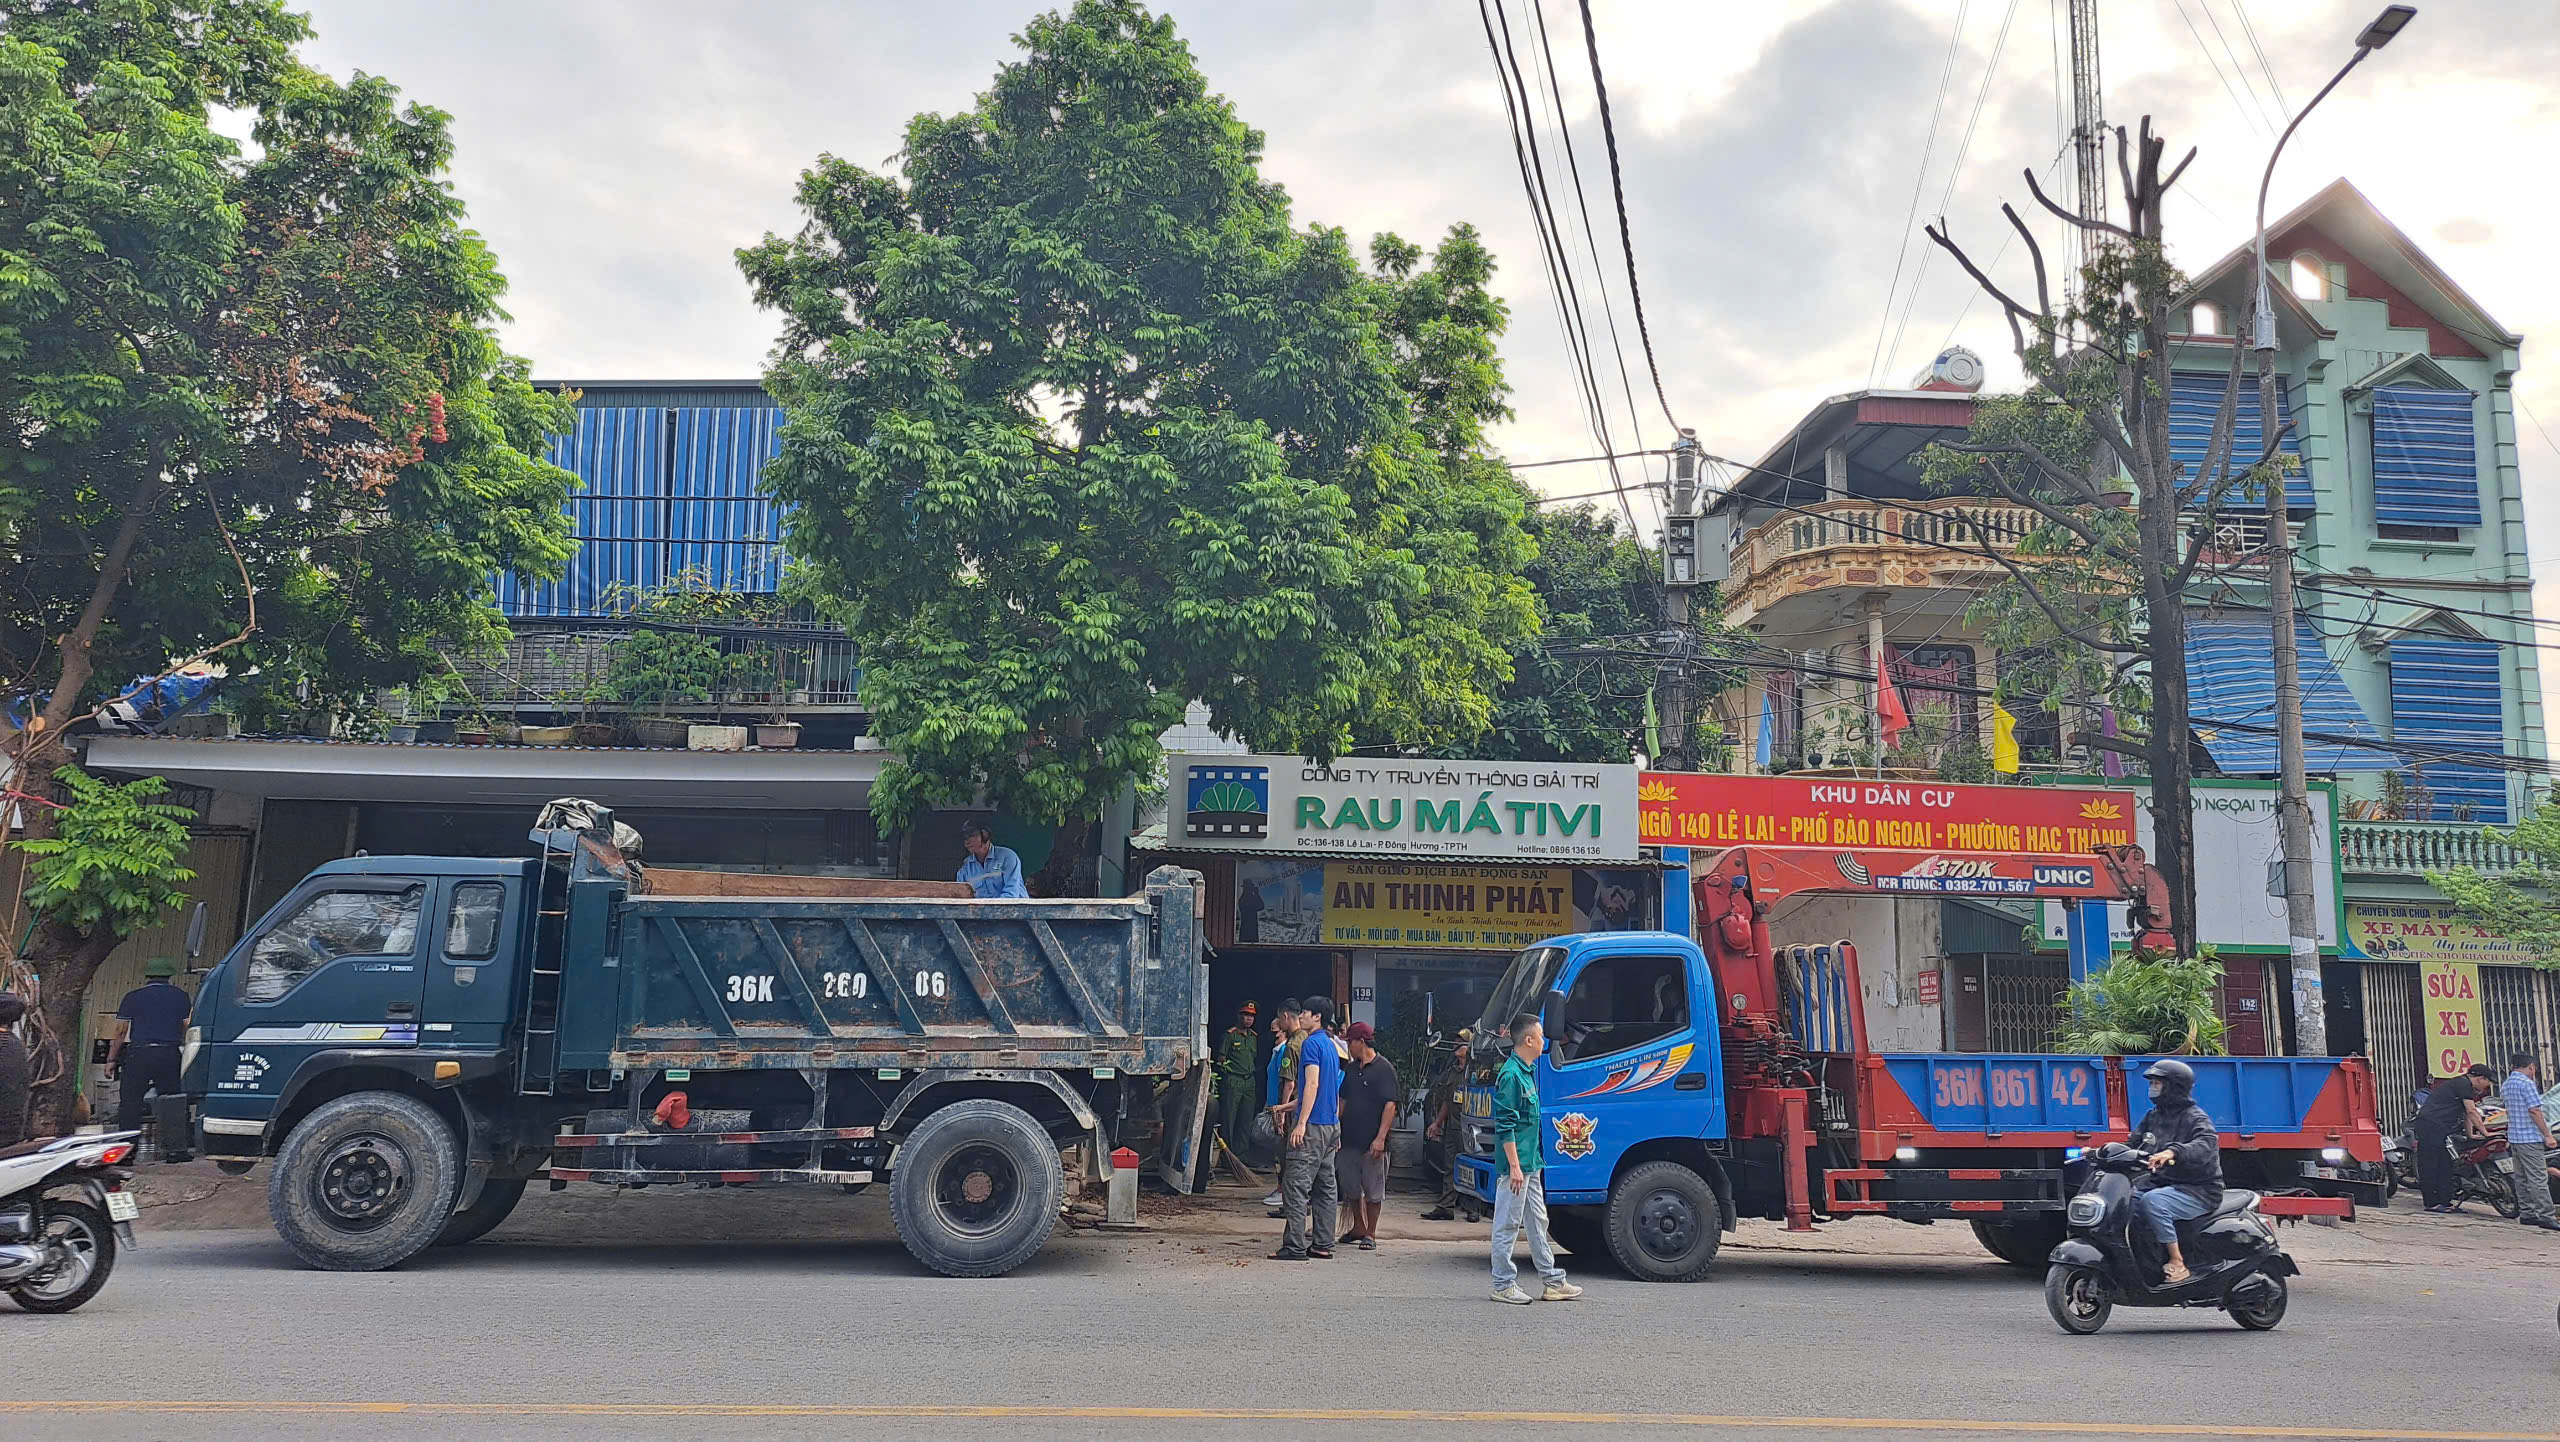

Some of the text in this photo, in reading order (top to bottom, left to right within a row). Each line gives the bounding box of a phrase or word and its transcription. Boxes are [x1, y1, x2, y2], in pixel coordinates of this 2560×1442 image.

[1302, 765, 1600, 789] CÔNG TY TRUYỀN THÔNG GIẢI TRÍ
[1811, 784, 1955, 808] KHU DÂN CƯ
[1296, 796, 1402, 831] RAU
[1639, 806, 1672, 838] NGÕ
[1678, 811, 1710, 839] 140
[1717, 808, 1739, 841] LÊ
[1744, 814, 1776, 842] LAI
[1791, 809, 1829, 844] PHỐ
[1833, 812, 1870, 846] BÀO
[1947, 818, 2021, 851] PHƯỜNG
[1347, 839, 1358, 849] Lê
[1410, 841, 1439, 852] Hương
[1517, 844, 1548, 854] Hotline:
[1550, 845, 1570, 854] 0896
[1415, 866, 1446, 879] DỊCH
[2034, 869, 2091, 885] UNIC
[1902, 877, 1942, 891] HÙNG:
[1945, 879, 2031, 893] 0382.701.567
[1333, 881, 1564, 917] AN THỊNH PHÁT
[2356, 905, 2389, 917] CHUYÊN
[1406, 929, 1423, 942] MUA
[2363, 921, 2395, 935] XE
[2402, 920, 2453, 936] MÁY
[2437, 951, 2460, 960] CHO
[726, 975, 775, 1002] 36K
[2427, 963, 2474, 999] SỬA
[1355, 988, 1371, 997] 138
[2438, 1011, 2470, 1036] XE
[1604, 1059, 1629, 1072] THACO
[2441, 1048, 2473, 1074] GA
[1934, 1066, 2089, 1107] 36K 861 42
